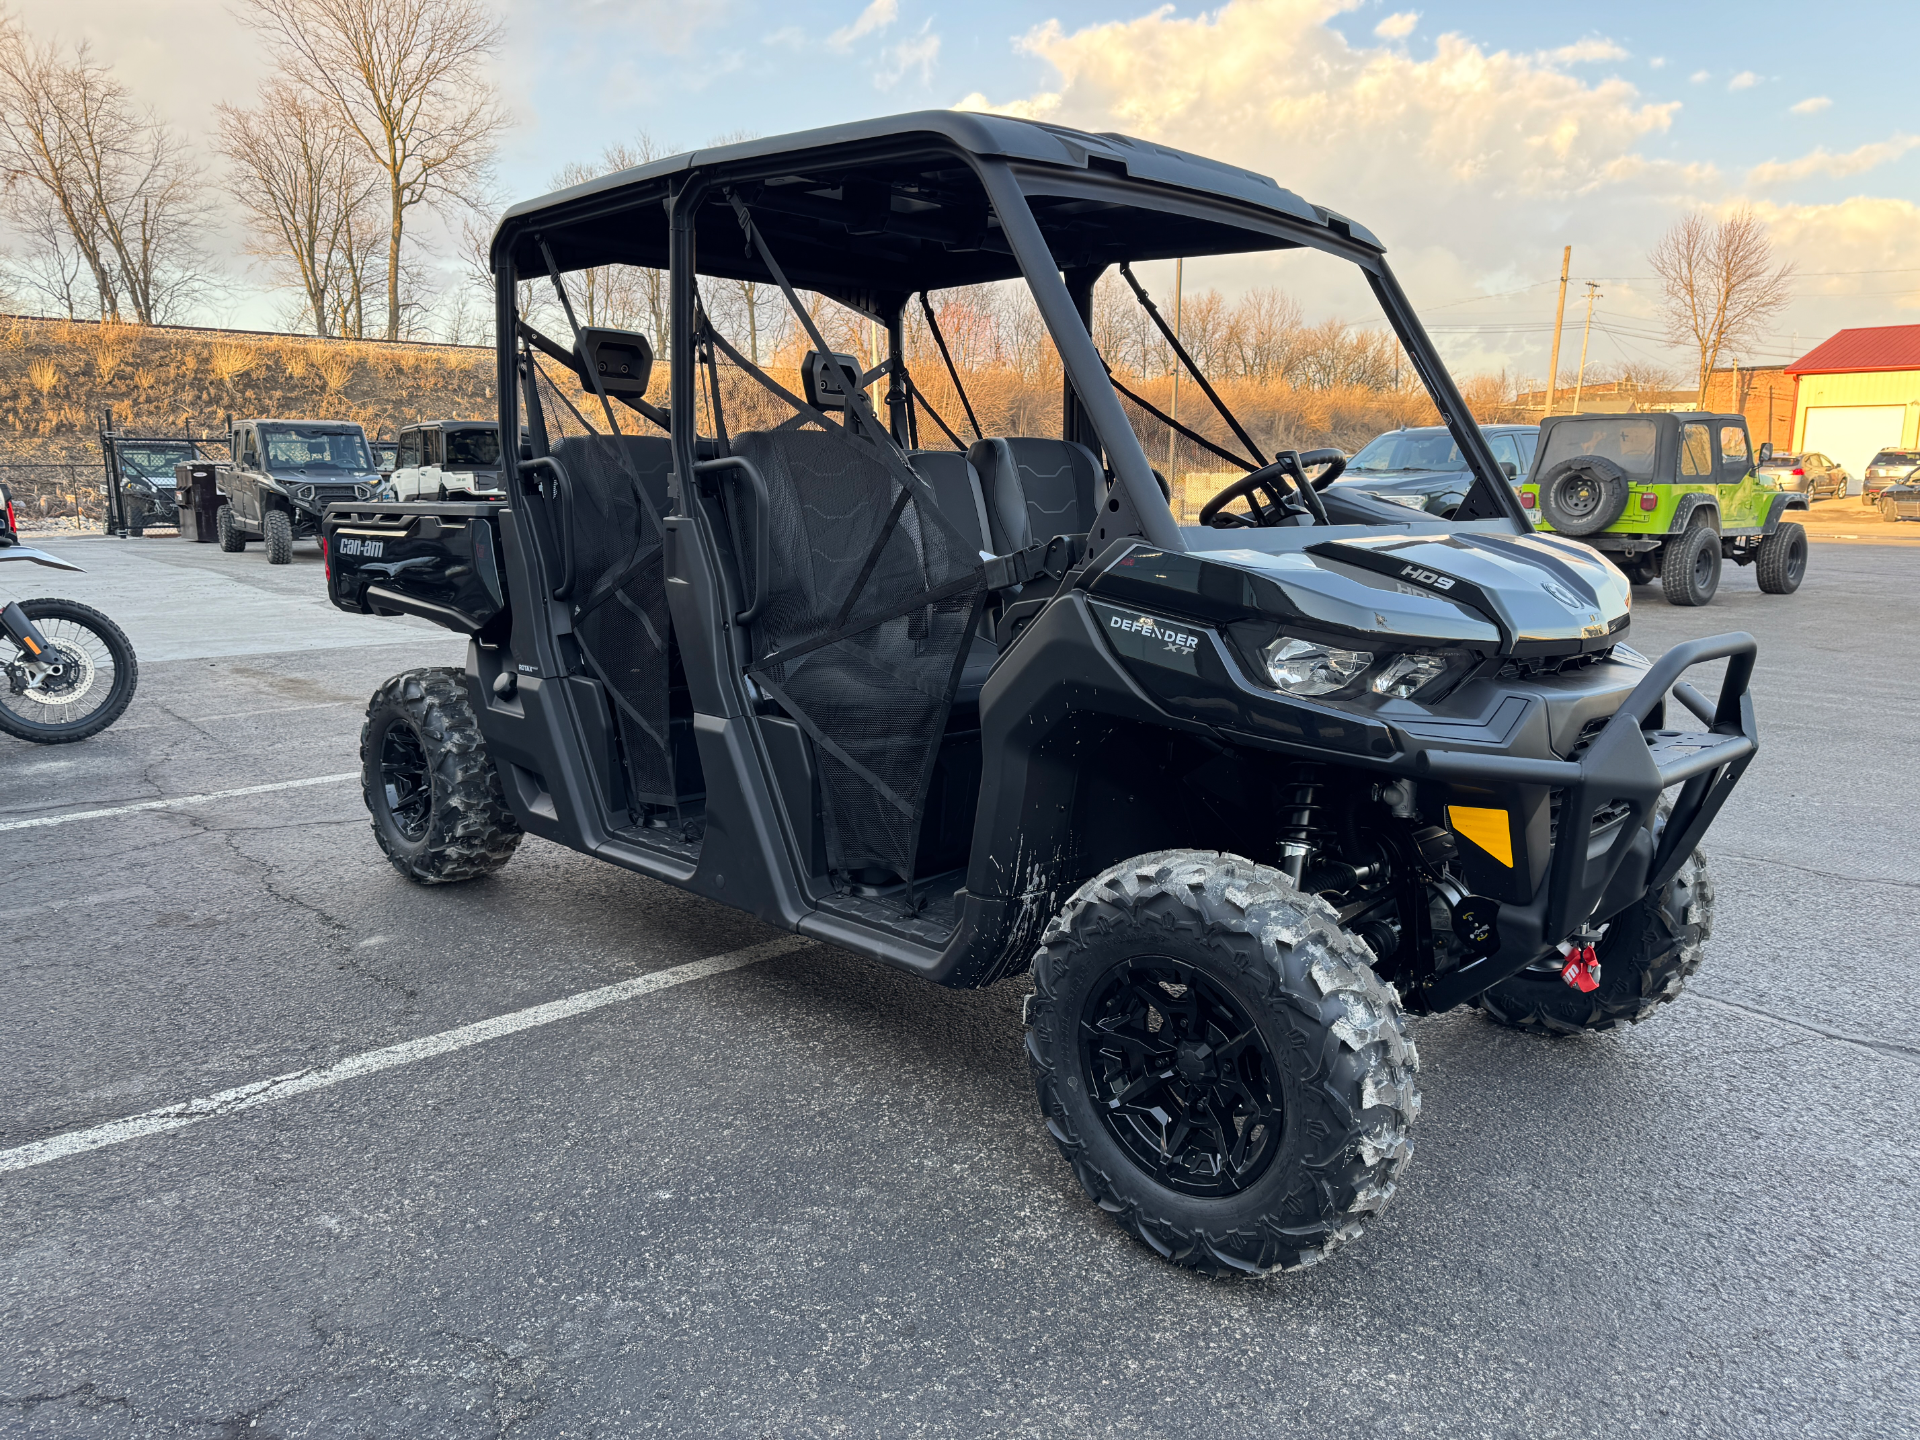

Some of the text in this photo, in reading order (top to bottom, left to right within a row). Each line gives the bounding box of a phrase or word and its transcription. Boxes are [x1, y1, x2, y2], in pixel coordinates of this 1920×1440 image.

[339, 538, 384, 558] can-am
[1400, 565, 1456, 590] HD9
[1110, 616, 1198, 649] DEFENDER
[1163, 642, 1195, 655] XT
